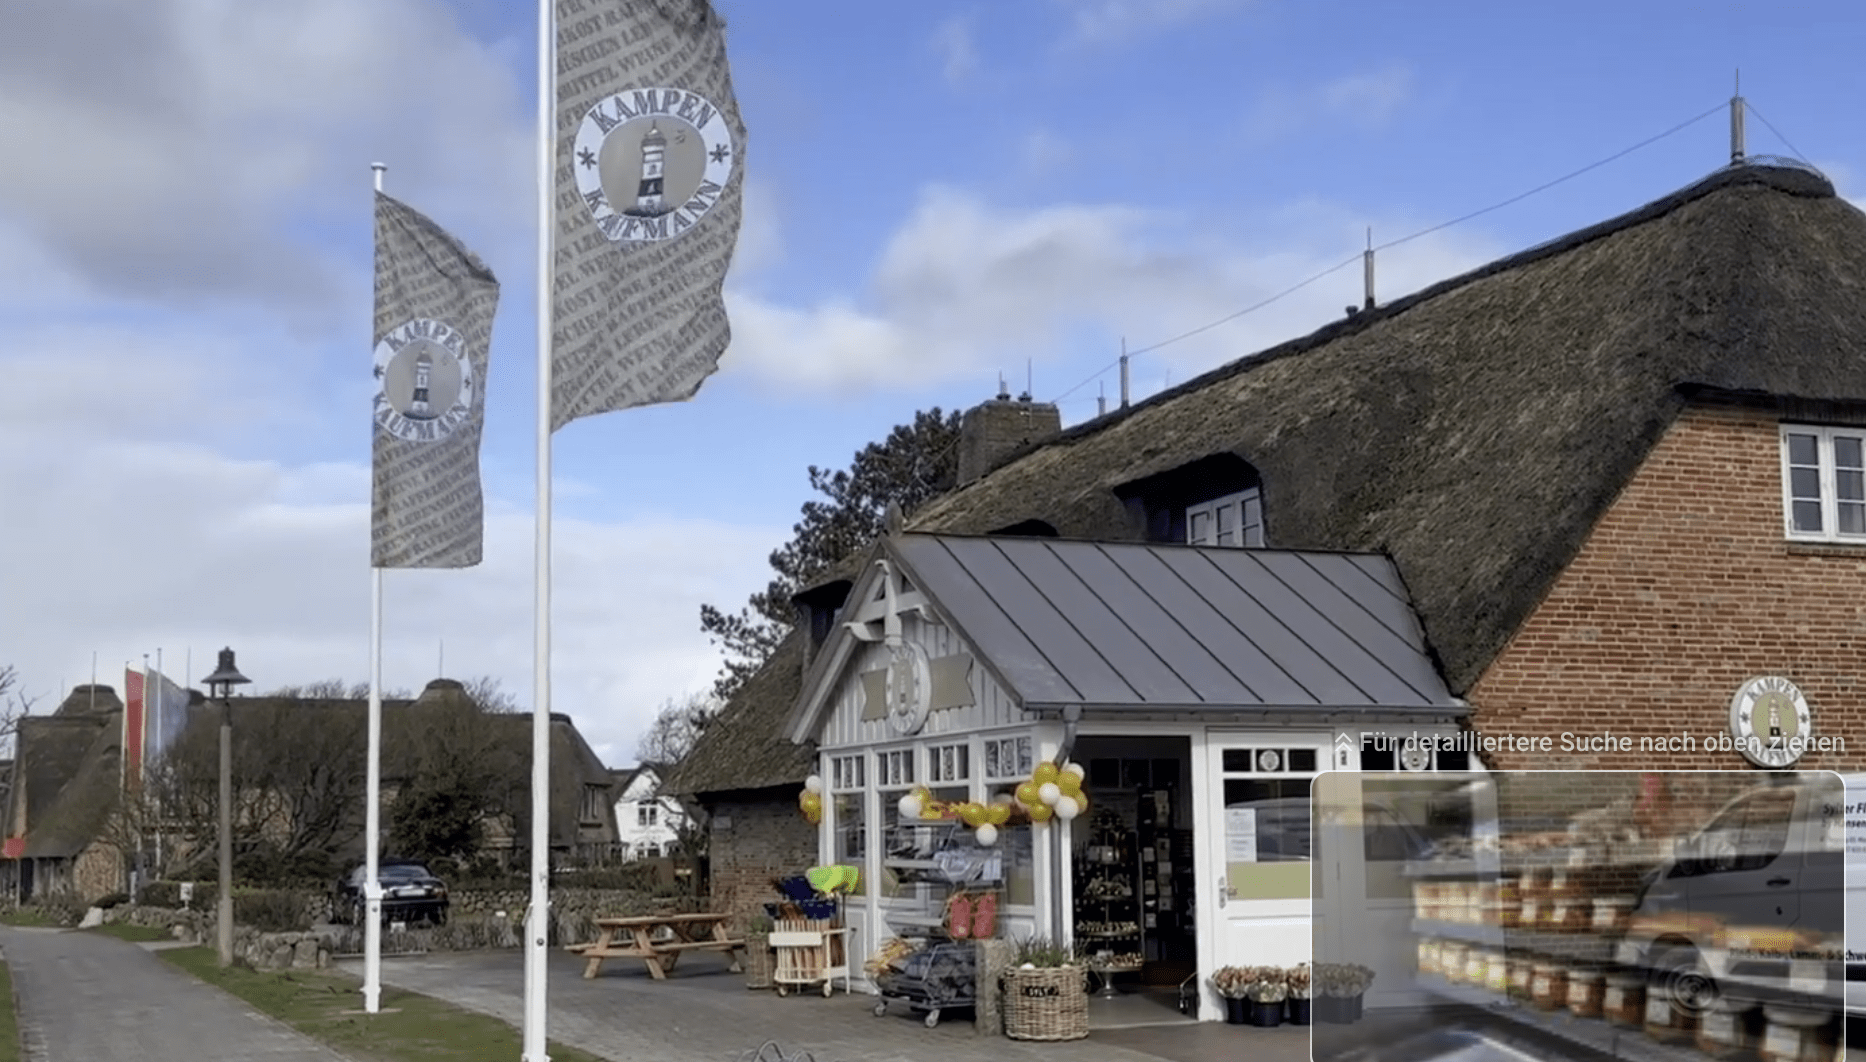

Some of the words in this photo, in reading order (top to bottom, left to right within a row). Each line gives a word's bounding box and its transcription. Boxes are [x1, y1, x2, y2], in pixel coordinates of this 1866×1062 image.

[588, 89, 717, 135] KAMPEN
[582, 179, 722, 240] KAUFMANN
[382, 320, 466, 361] KAMPEN
[1746, 678, 1800, 701] KAMPEN
